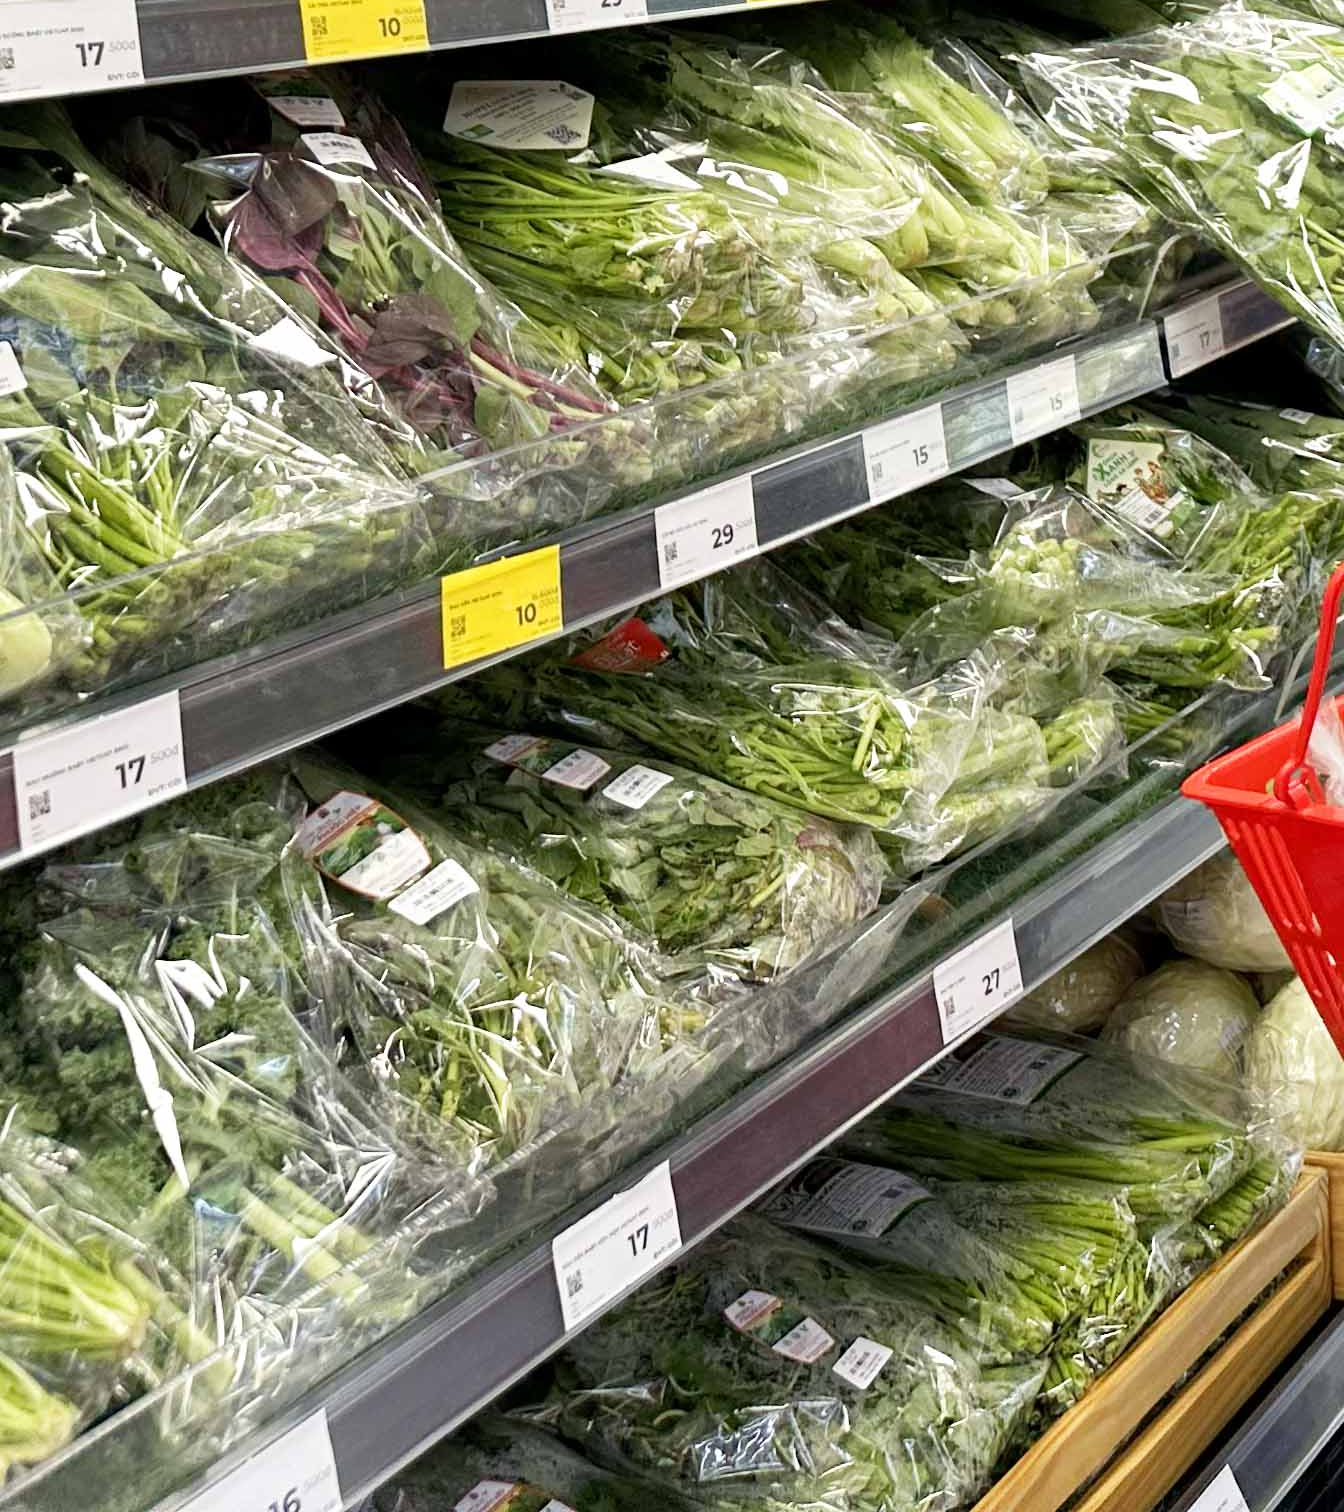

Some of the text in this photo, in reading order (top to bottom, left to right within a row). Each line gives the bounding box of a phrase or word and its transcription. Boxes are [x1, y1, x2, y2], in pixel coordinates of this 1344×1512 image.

[378, 17, 401, 38] 10
[75, 41, 104, 67] 17
[1050, 393, 1063, 409] 15
[912, 445, 928, 467] 15
[711, 523, 734, 550] 29
[516, 603, 536, 626] 10
[115, 754, 146, 789] 17
[982, 968, 1000, 996] 27
[628, 1223, 649, 1257] 17
